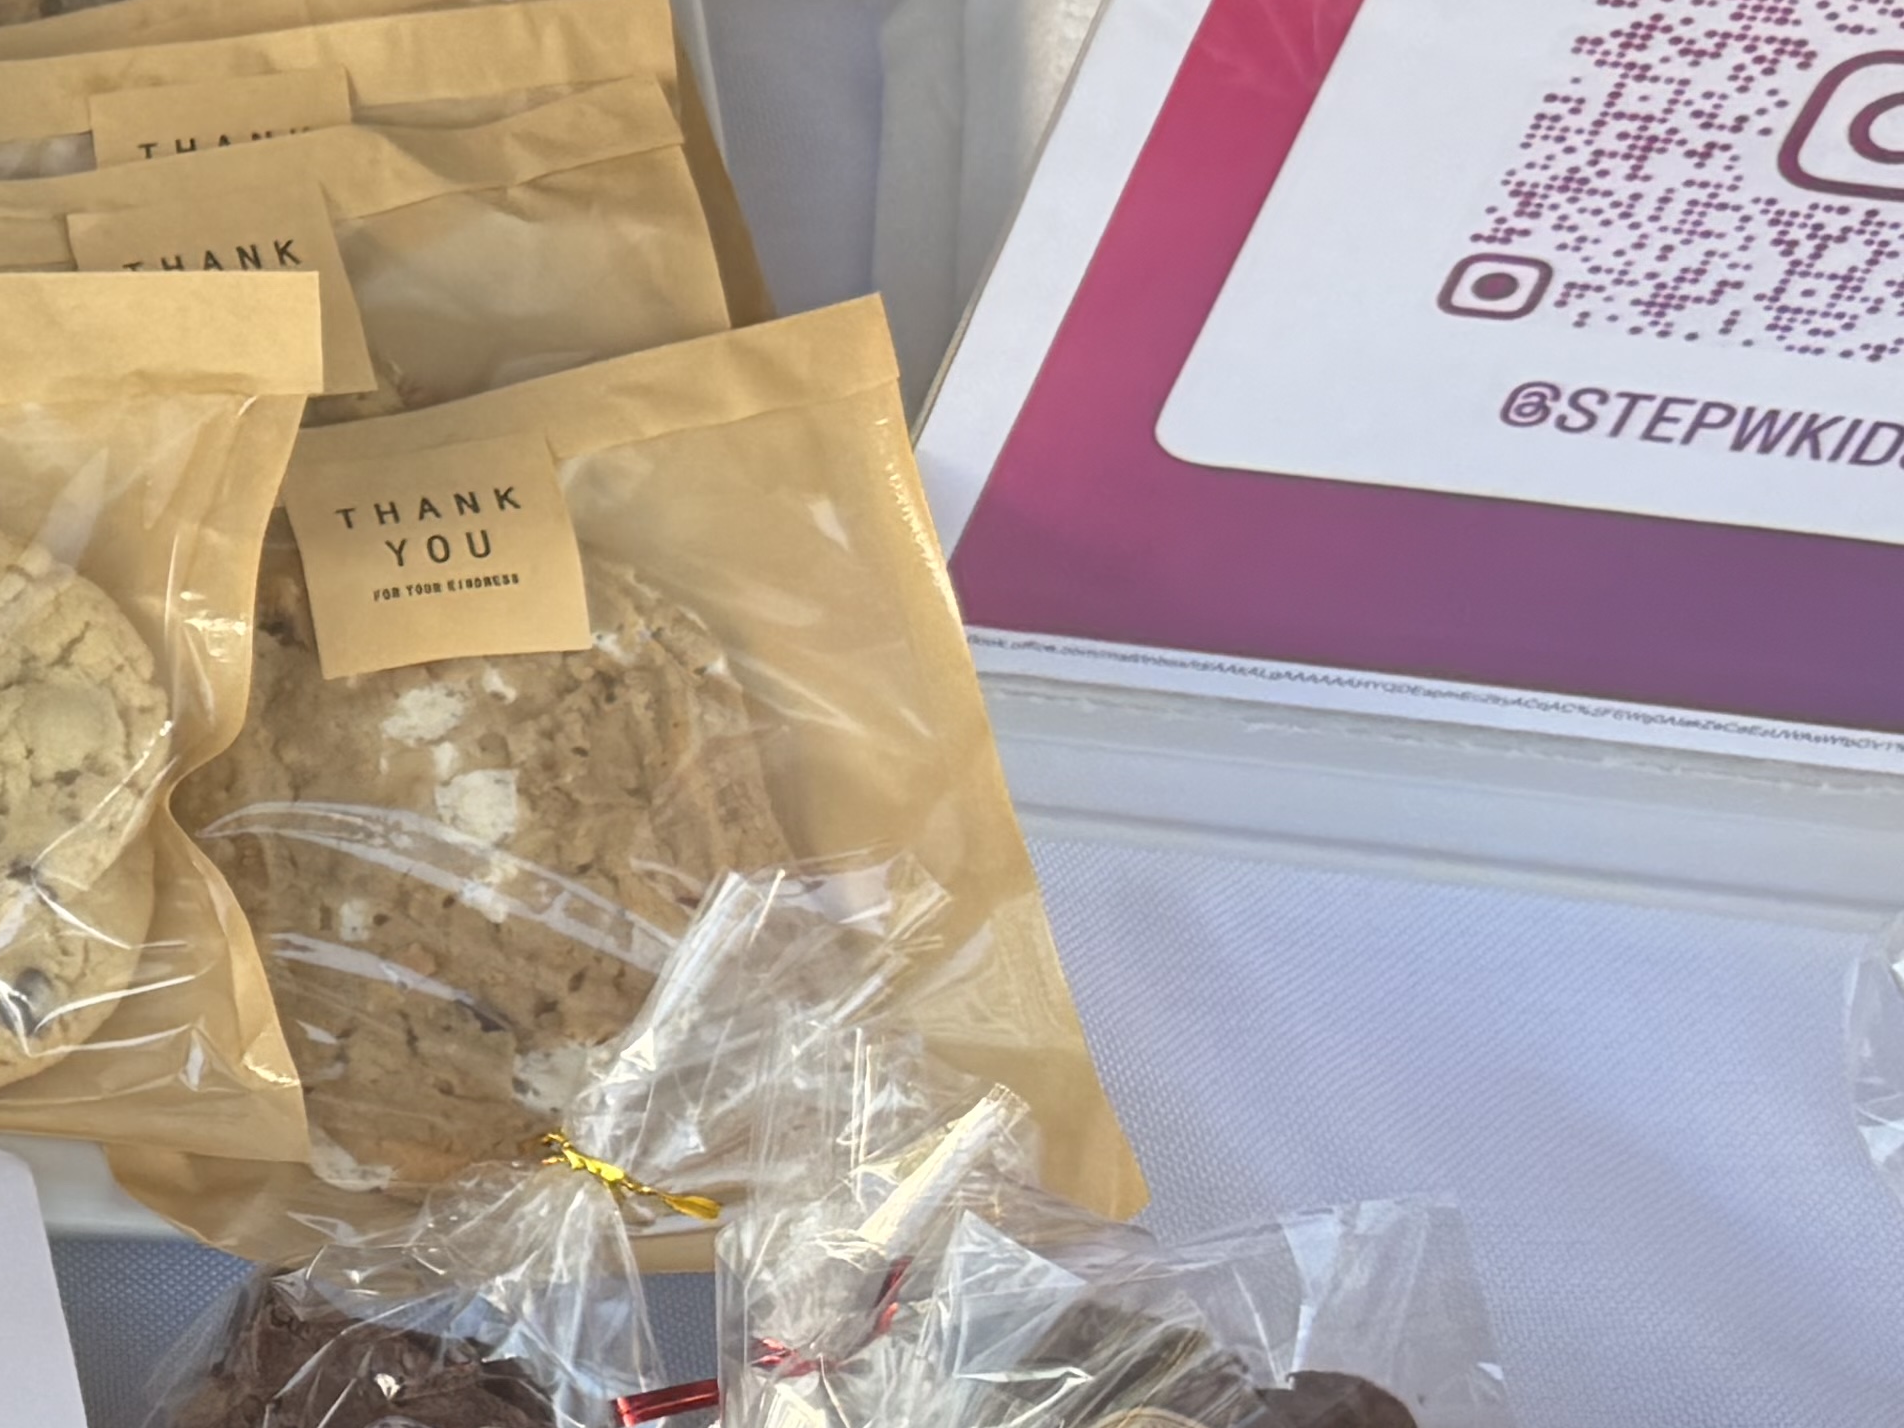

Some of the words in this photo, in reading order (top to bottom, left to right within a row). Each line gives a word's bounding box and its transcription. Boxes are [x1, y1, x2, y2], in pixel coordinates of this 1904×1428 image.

[1499, 380, 1904, 470] @STEPWKID
[335, 486, 521, 530] THANK
[385, 529, 492, 568] YOU
[373, 587, 401, 602] FOR
[405, 582, 442, 597] YOUR
[447, 573, 520, 592] KINDNESS
